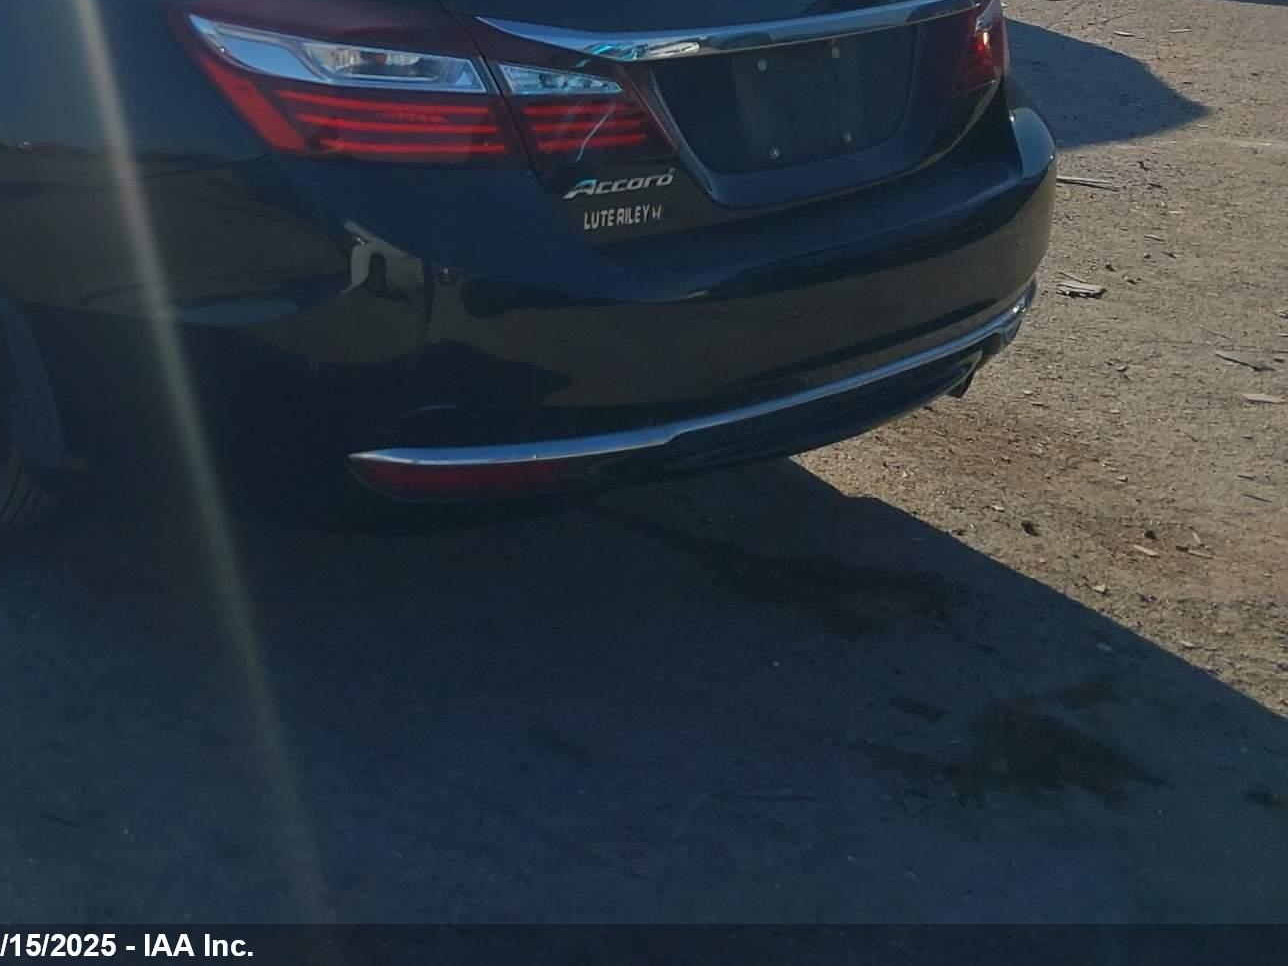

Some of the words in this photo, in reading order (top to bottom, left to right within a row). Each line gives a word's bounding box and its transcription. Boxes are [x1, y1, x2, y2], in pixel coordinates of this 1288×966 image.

[562, 168, 675, 199] Accord
[584, 209, 614, 230] LUTE
[616, 204, 649, 226] RILEY
